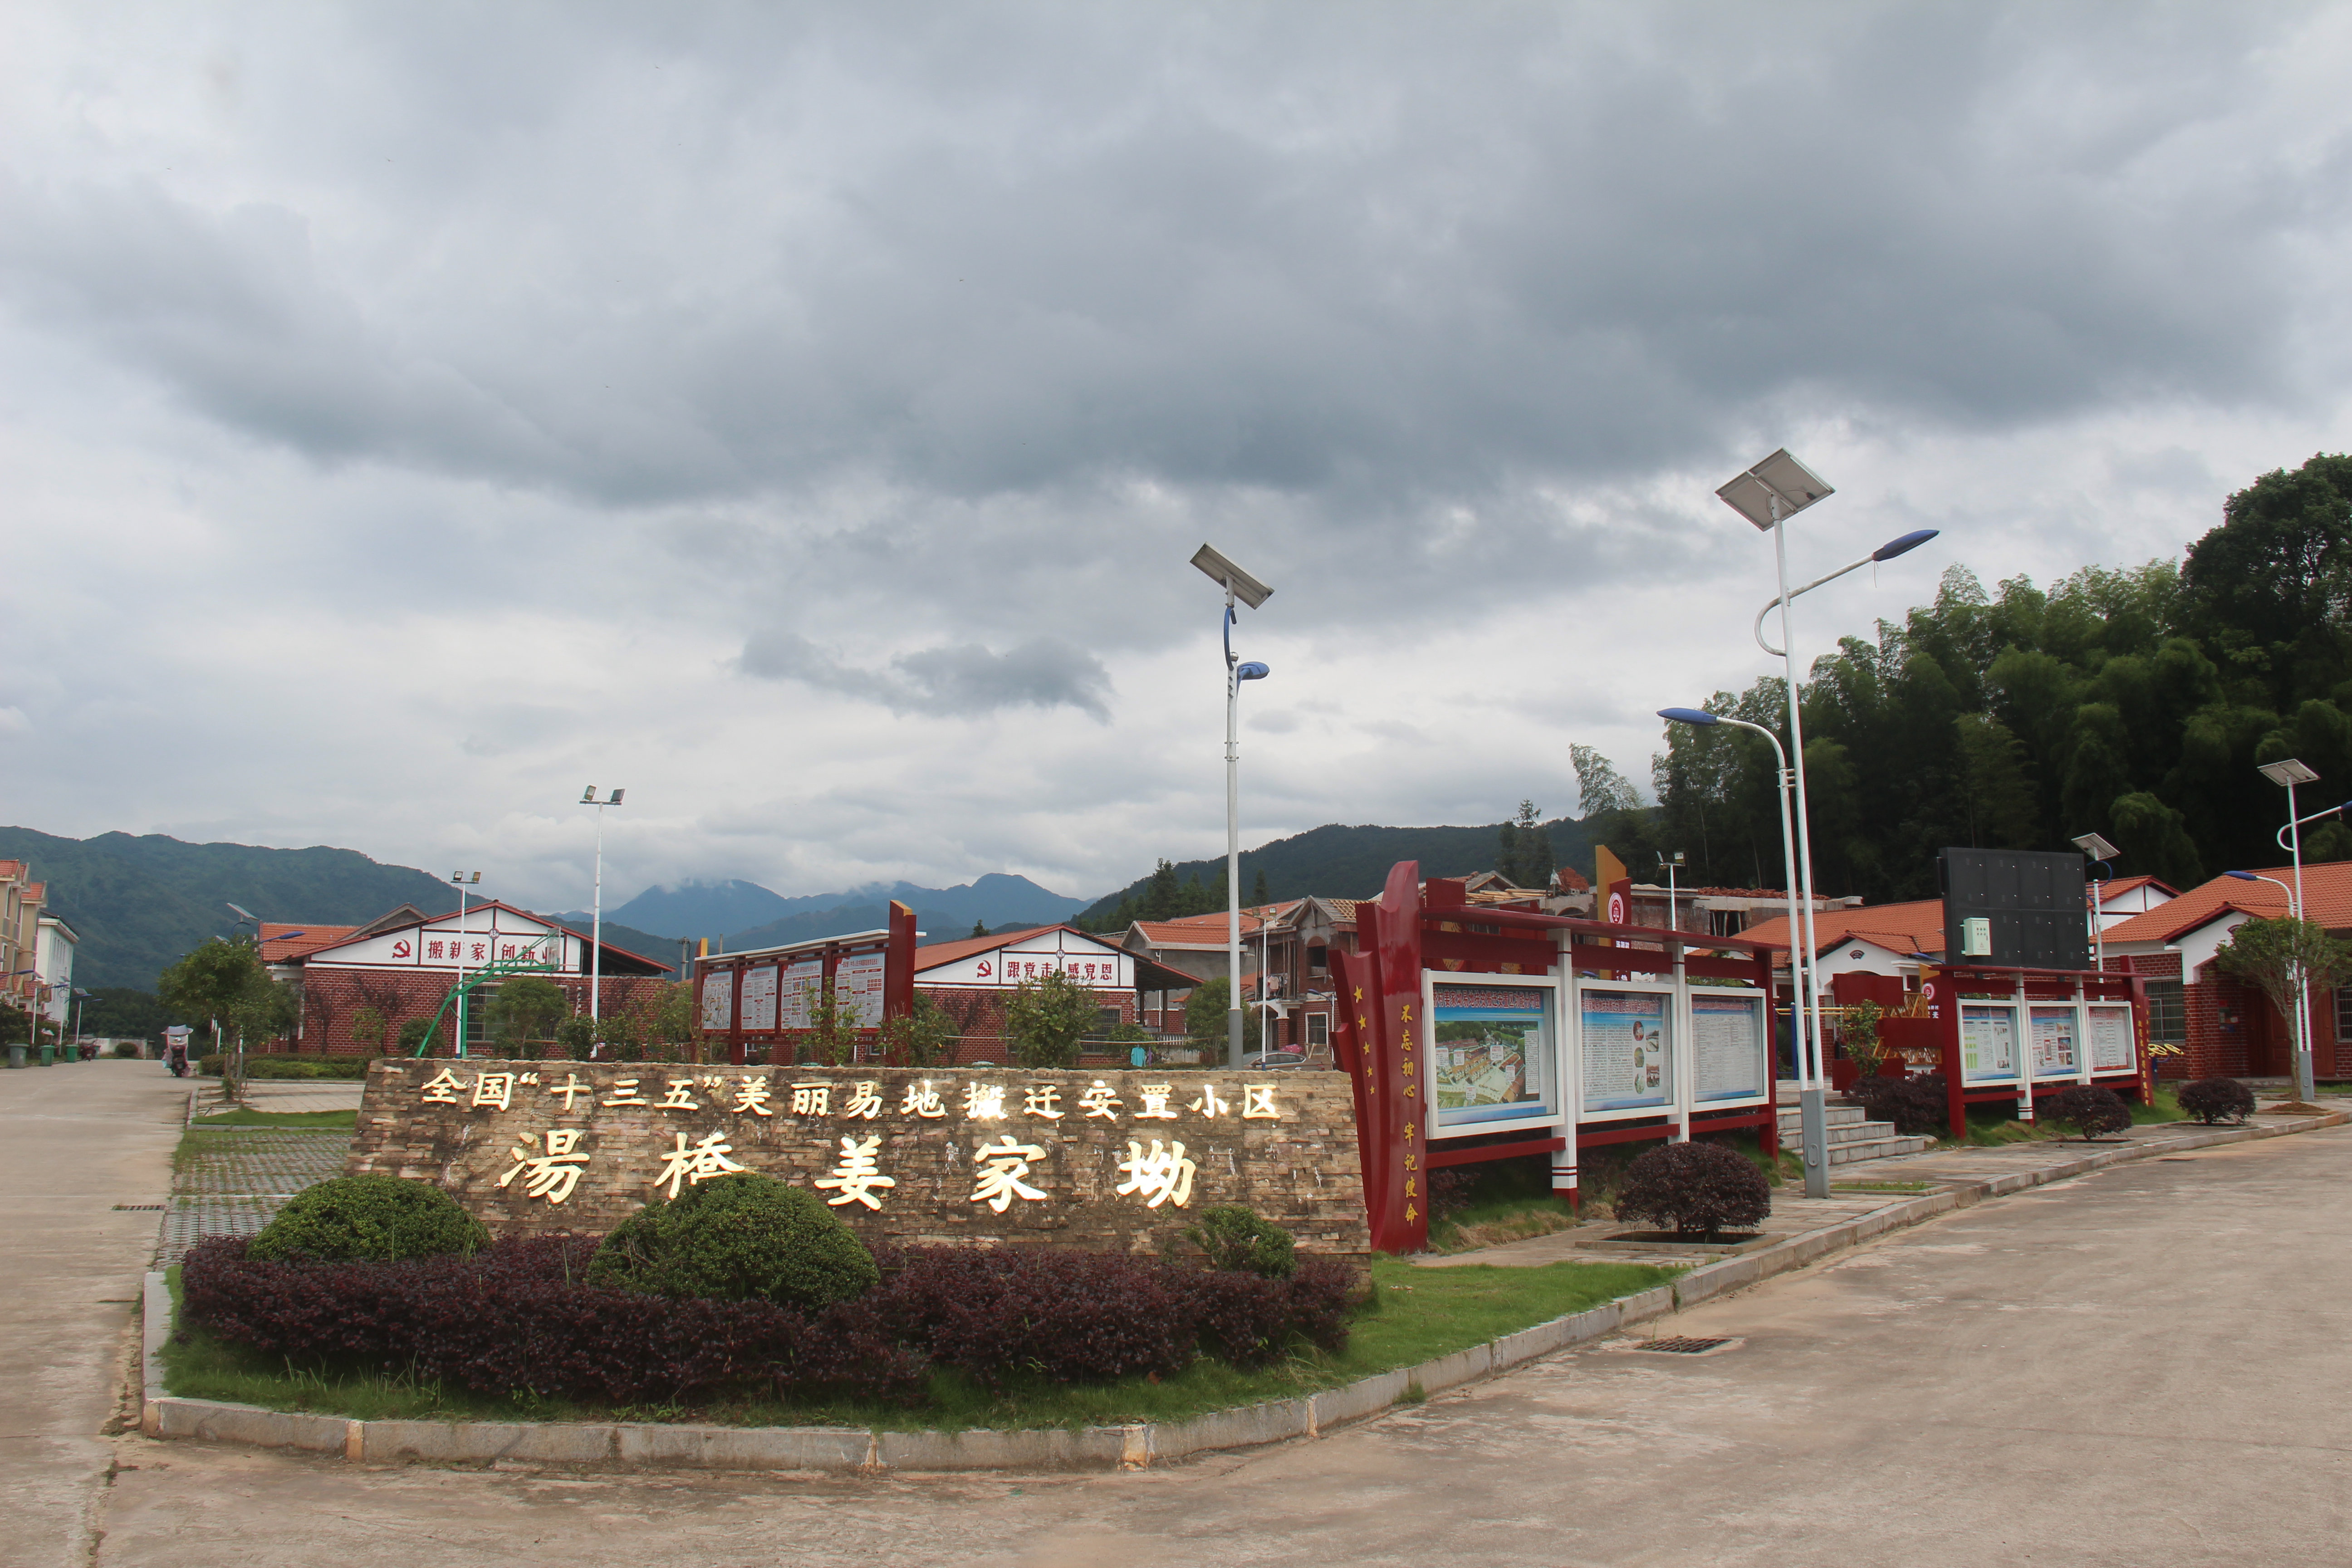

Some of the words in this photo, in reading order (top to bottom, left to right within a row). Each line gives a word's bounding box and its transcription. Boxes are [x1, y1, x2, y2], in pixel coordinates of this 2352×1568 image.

[428, 940, 486, 960] 搬新家
[1008, 961, 1053, 979] 跟党走
[1068, 963, 1112, 980] 感党恩
[1401, 1004, 1416, 1098] 不忘初心
[1404, 1122, 1418, 1227] 牢记使命
